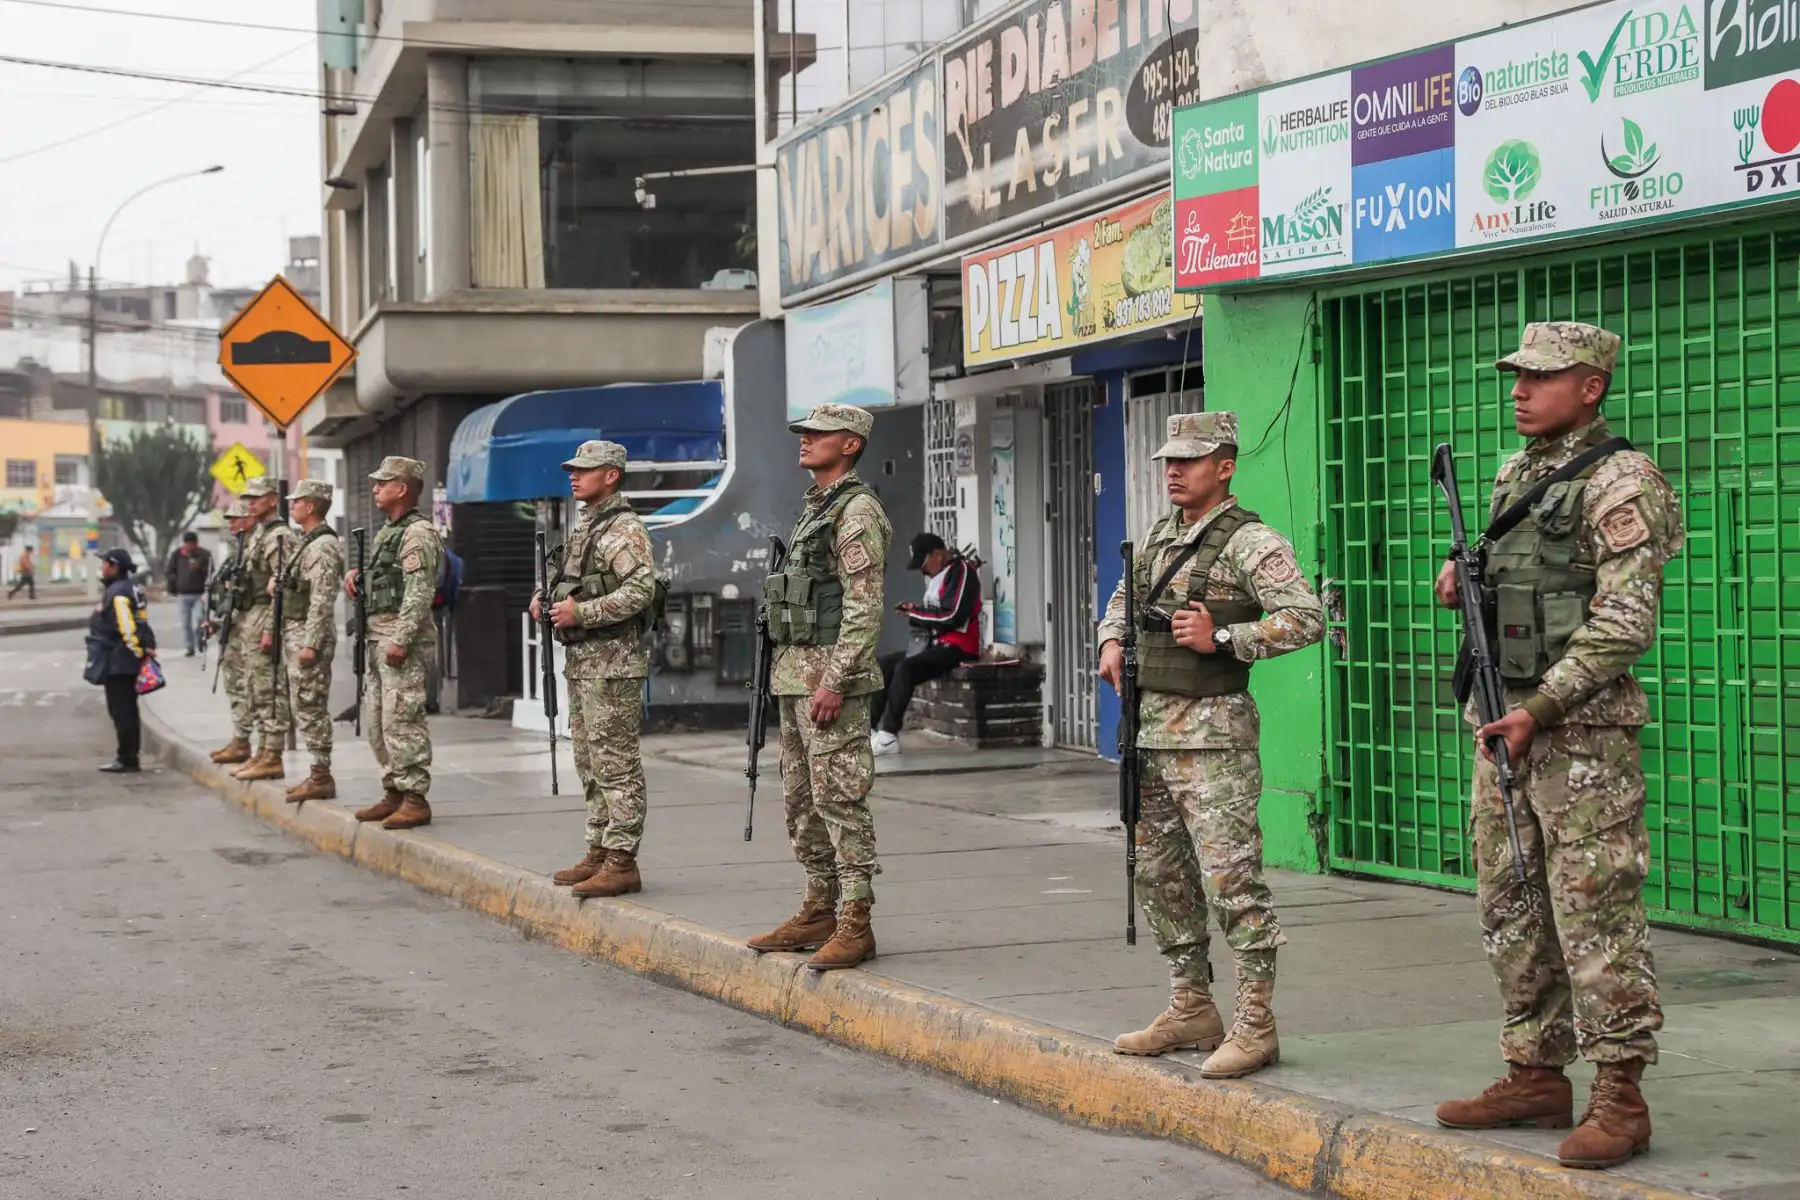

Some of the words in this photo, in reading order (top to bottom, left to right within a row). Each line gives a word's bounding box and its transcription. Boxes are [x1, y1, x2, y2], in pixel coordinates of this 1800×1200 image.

[1710, 0, 1800, 62] Bioli
[1460, 80, 1480, 105] Bio
[1485, 49, 1569, 93] naturista
[1615, 79, 1656, 97] PRODUCTOS
[1656, 69, 1698, 87] NATURALES
[1354, 72, 1452, 126] OMNILIFE
[1485, 98, 1498, 111] DEL
[1498, 91, 1530, 108] BIOLOGO
[1530, 87, 1549, 100] BLAS
[1549, 82, 1569, 96] SILVA
[1280, 100, 1348, 133] HERBALIFE
[1357, 127, 1377, 140] GENTE
[1377, 124, 1392, 136] QUE
[1391, 121, 1411, 133] CUIDA
[1411, 119, 1417, 128] A
[1417, 116, 1427, 127] LA
[1427, 112, 1449, 125] GENTE
[984, 87, 1124, 209] LASER
[1204, 121, 1245, 148] Santa
[1280, 121, 1349, 153] NUTRITION
[1204, 146, 1254, 174] Natura
[1746, 161, 1800, 192] DX
[779, 79, 938, 285] VARICES
[1183, 209, 1201, 235] La
[1356, 182, 1451, 232] FUXION
[1470, 200, 1557, 233] AnyLife
[1598, 207, 1628, 220] SALUD
[1630, 198, 1675, 216] NATURAL
[1094, 218, 1101, 250] 2
[1101, 217, 1124, 248] Fam.
[1262, 203, 1343, 249] MASON
[1481, 230, 1499, 239] Vive
[1509, 221, 1557, 234] Naturalmente
[1179, 232, 1258, 275] Milenaria
[1263, 240, 1343, 260] NATURAL
[967, 238, 1063, 354] PIZZA
[1115, 297, 1134, 328] 937
[1152, 285, 1172, 318] 802
